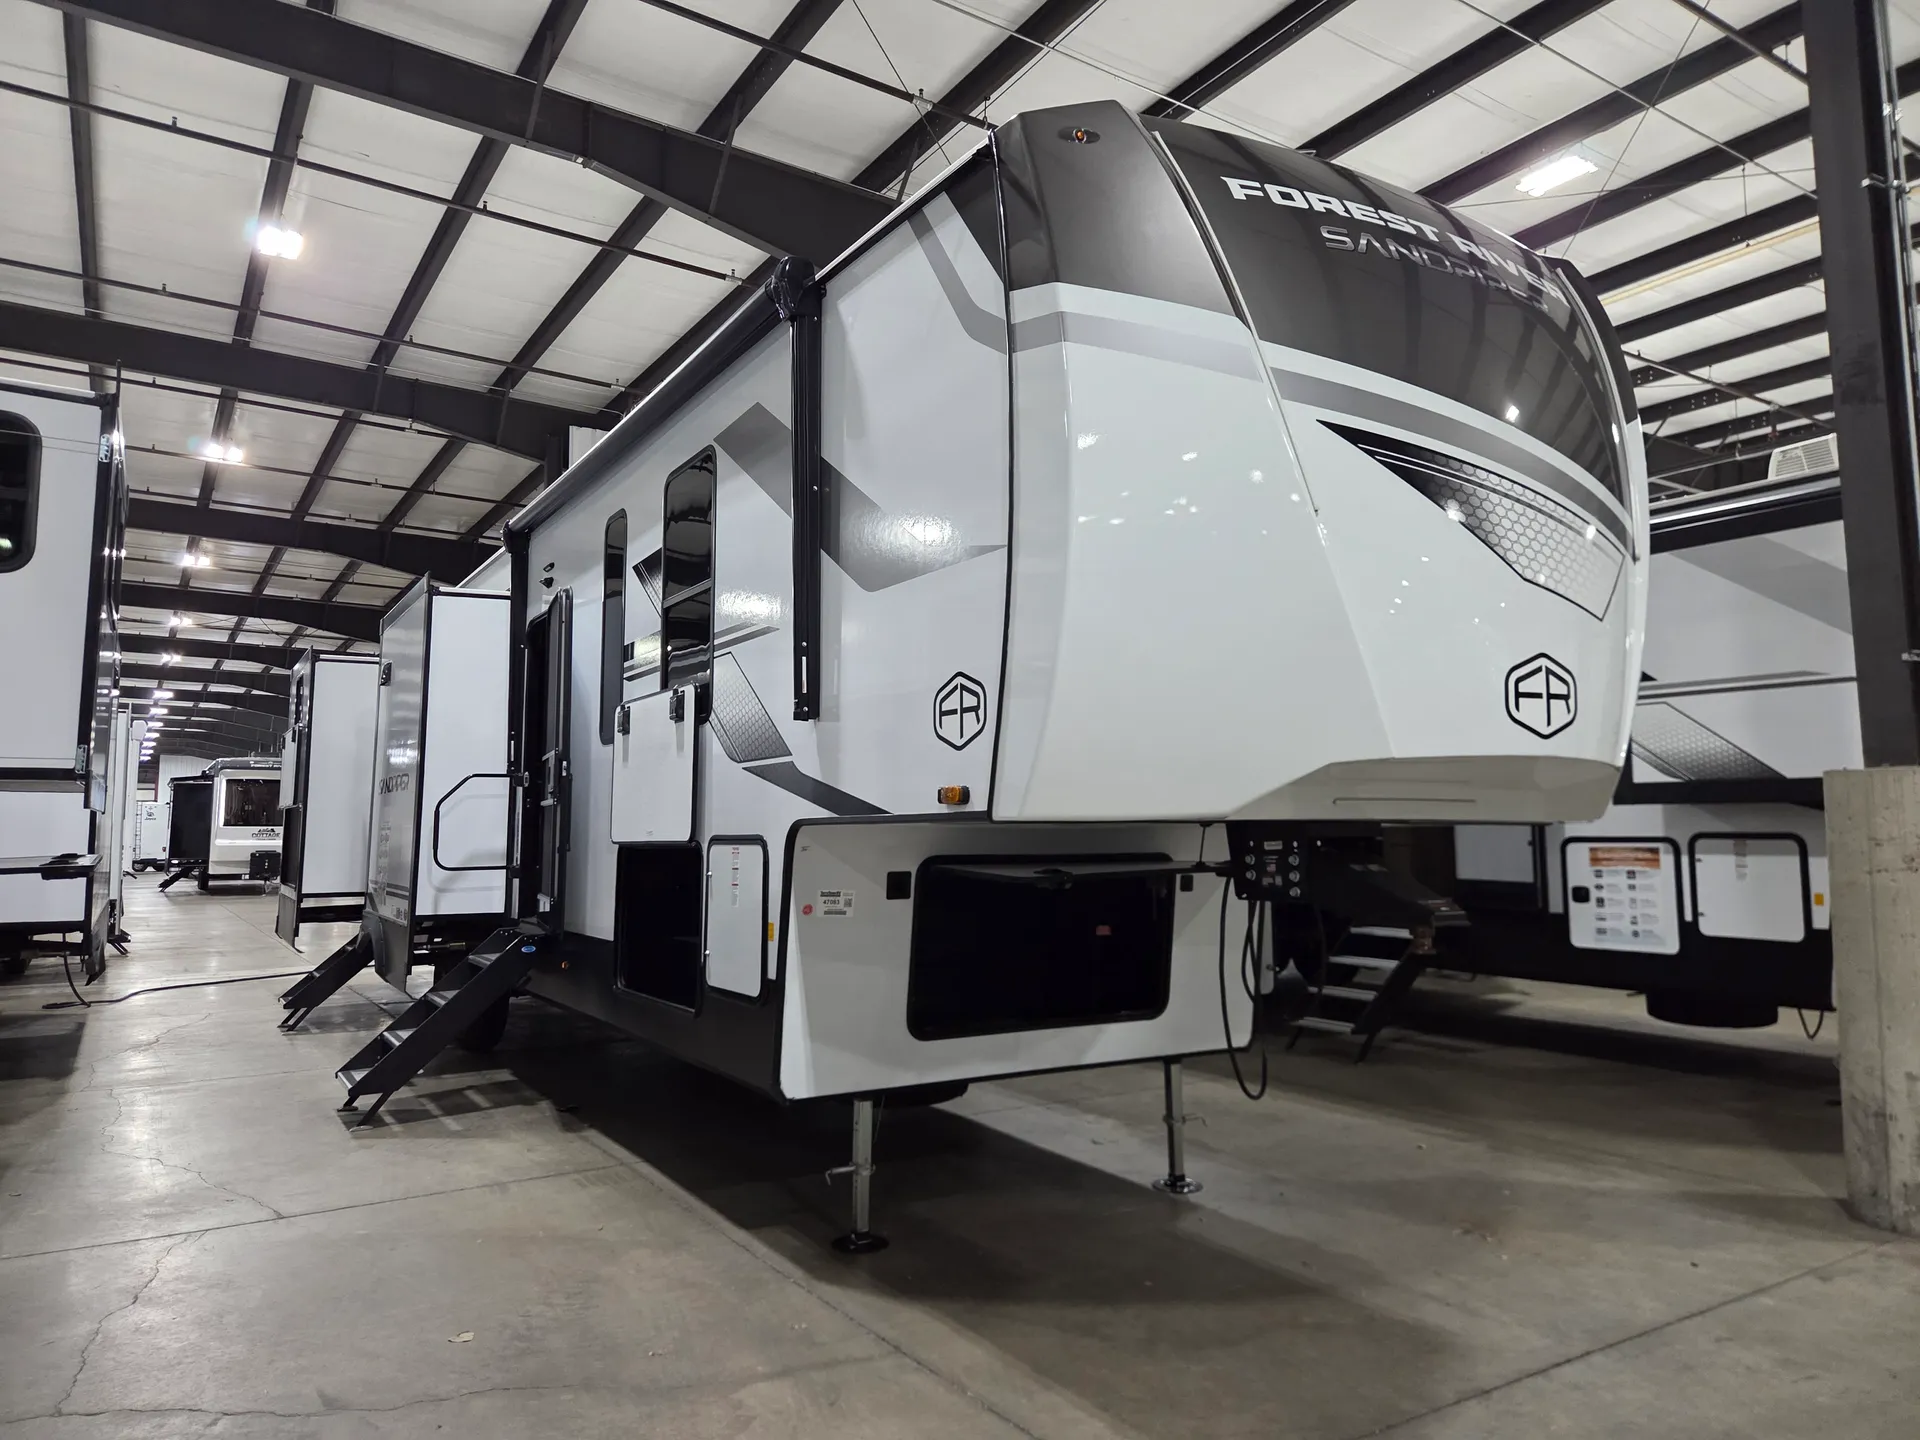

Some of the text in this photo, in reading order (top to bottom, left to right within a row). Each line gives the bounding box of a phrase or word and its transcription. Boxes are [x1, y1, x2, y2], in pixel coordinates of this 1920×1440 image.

[1220, 176, 1571, 308] FOREST RIVER
[1320, 225, 1549, 312] SANDPIPER
[938, 681, 981, 741] FR
[1514, 664, 1571, 728] FR
